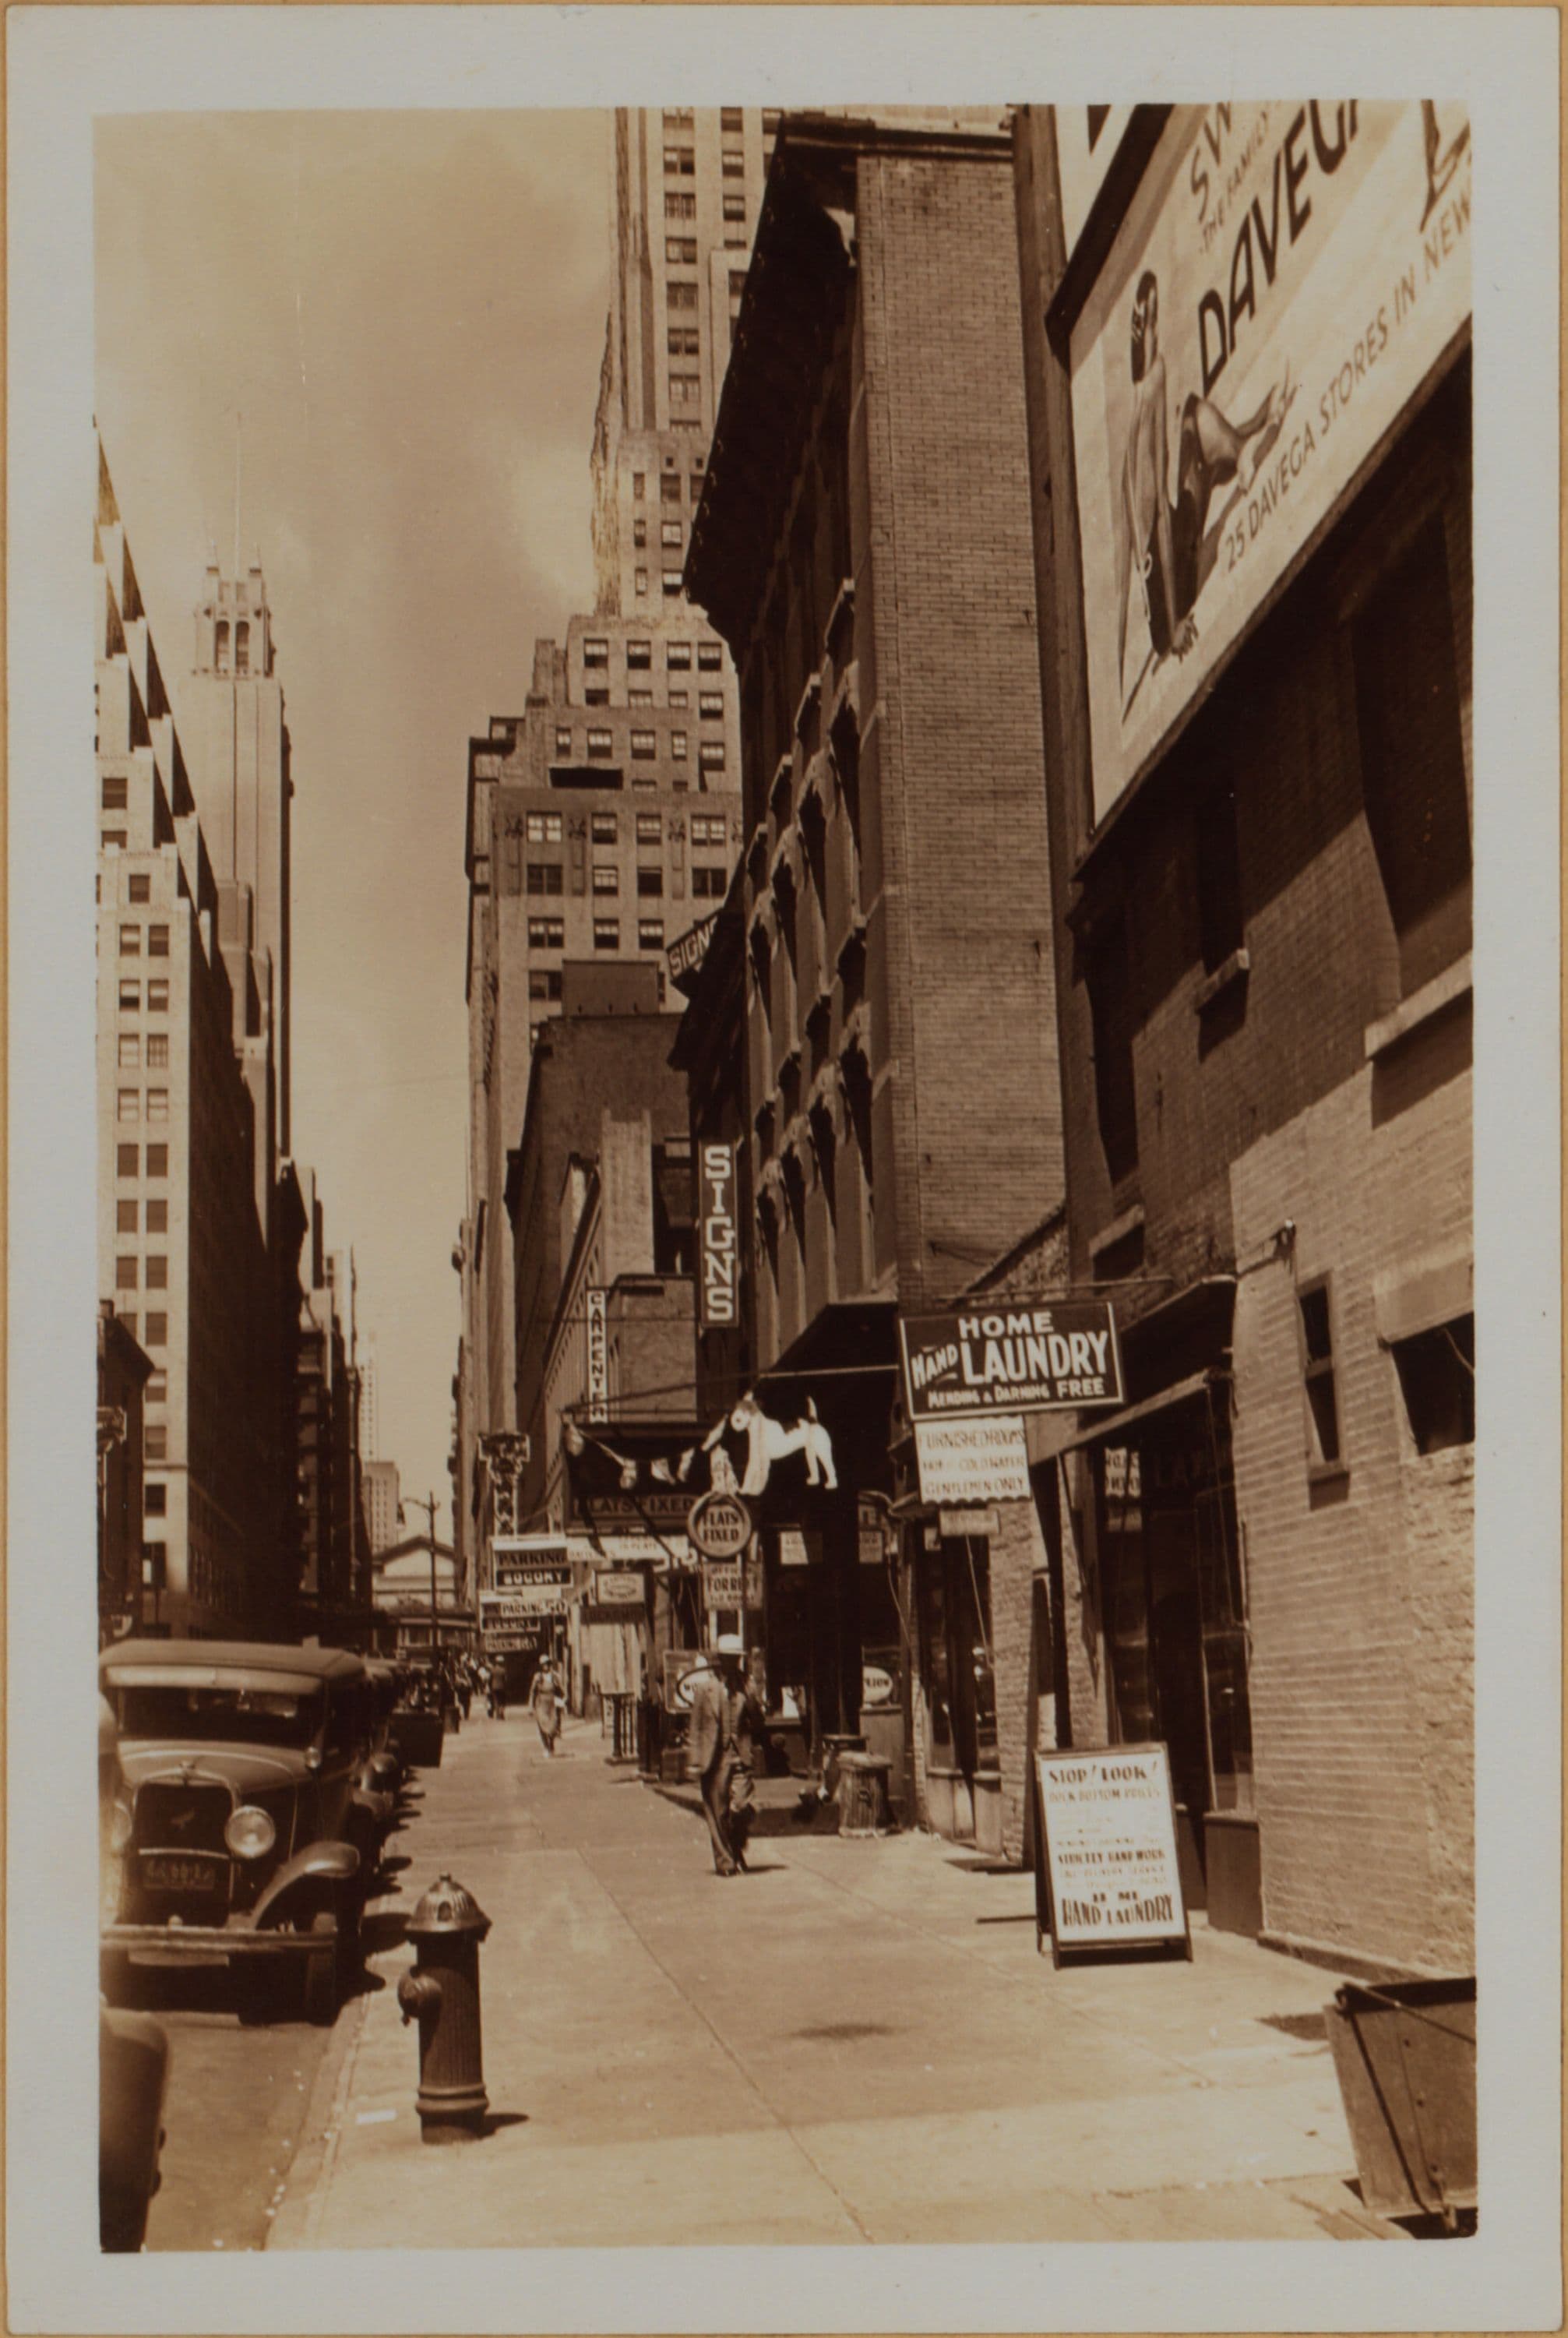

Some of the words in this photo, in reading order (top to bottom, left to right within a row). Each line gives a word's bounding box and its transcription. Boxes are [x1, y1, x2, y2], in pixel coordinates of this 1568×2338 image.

[1198, 99, 1358, 399] DAVEG
[1224, 528, 1247, 573] 25
[1248, 422, 1316, 541] DAVEGA
[1319, 305, 1389, 438] STORES
[1394, 262, 1418, 326] IN
[704, 1144, 735, 1322] SIGNS
[958, 1311, 1055, 1339] HOME
[590, 1292, 605, 1418] CARPENTER
[911, 1343, 958, 1389] HAND
[960, 1331, 1108, 1385] LAUNDRY
[994, 1383, 1050, 1402] DARNING
[1056, 1377, 1105, 1398] FREE
[703, 1511, 739, 1526] FLATS
[703, 1529, 739, 1542] FIXED
[707, 1576, 729, 1593] FOR
[730, 1575, 758, 1592] RET
[1061, 1897, 1102, 1927] HAND
[1106, 1893, 1173, 1925] LAUNDRY
